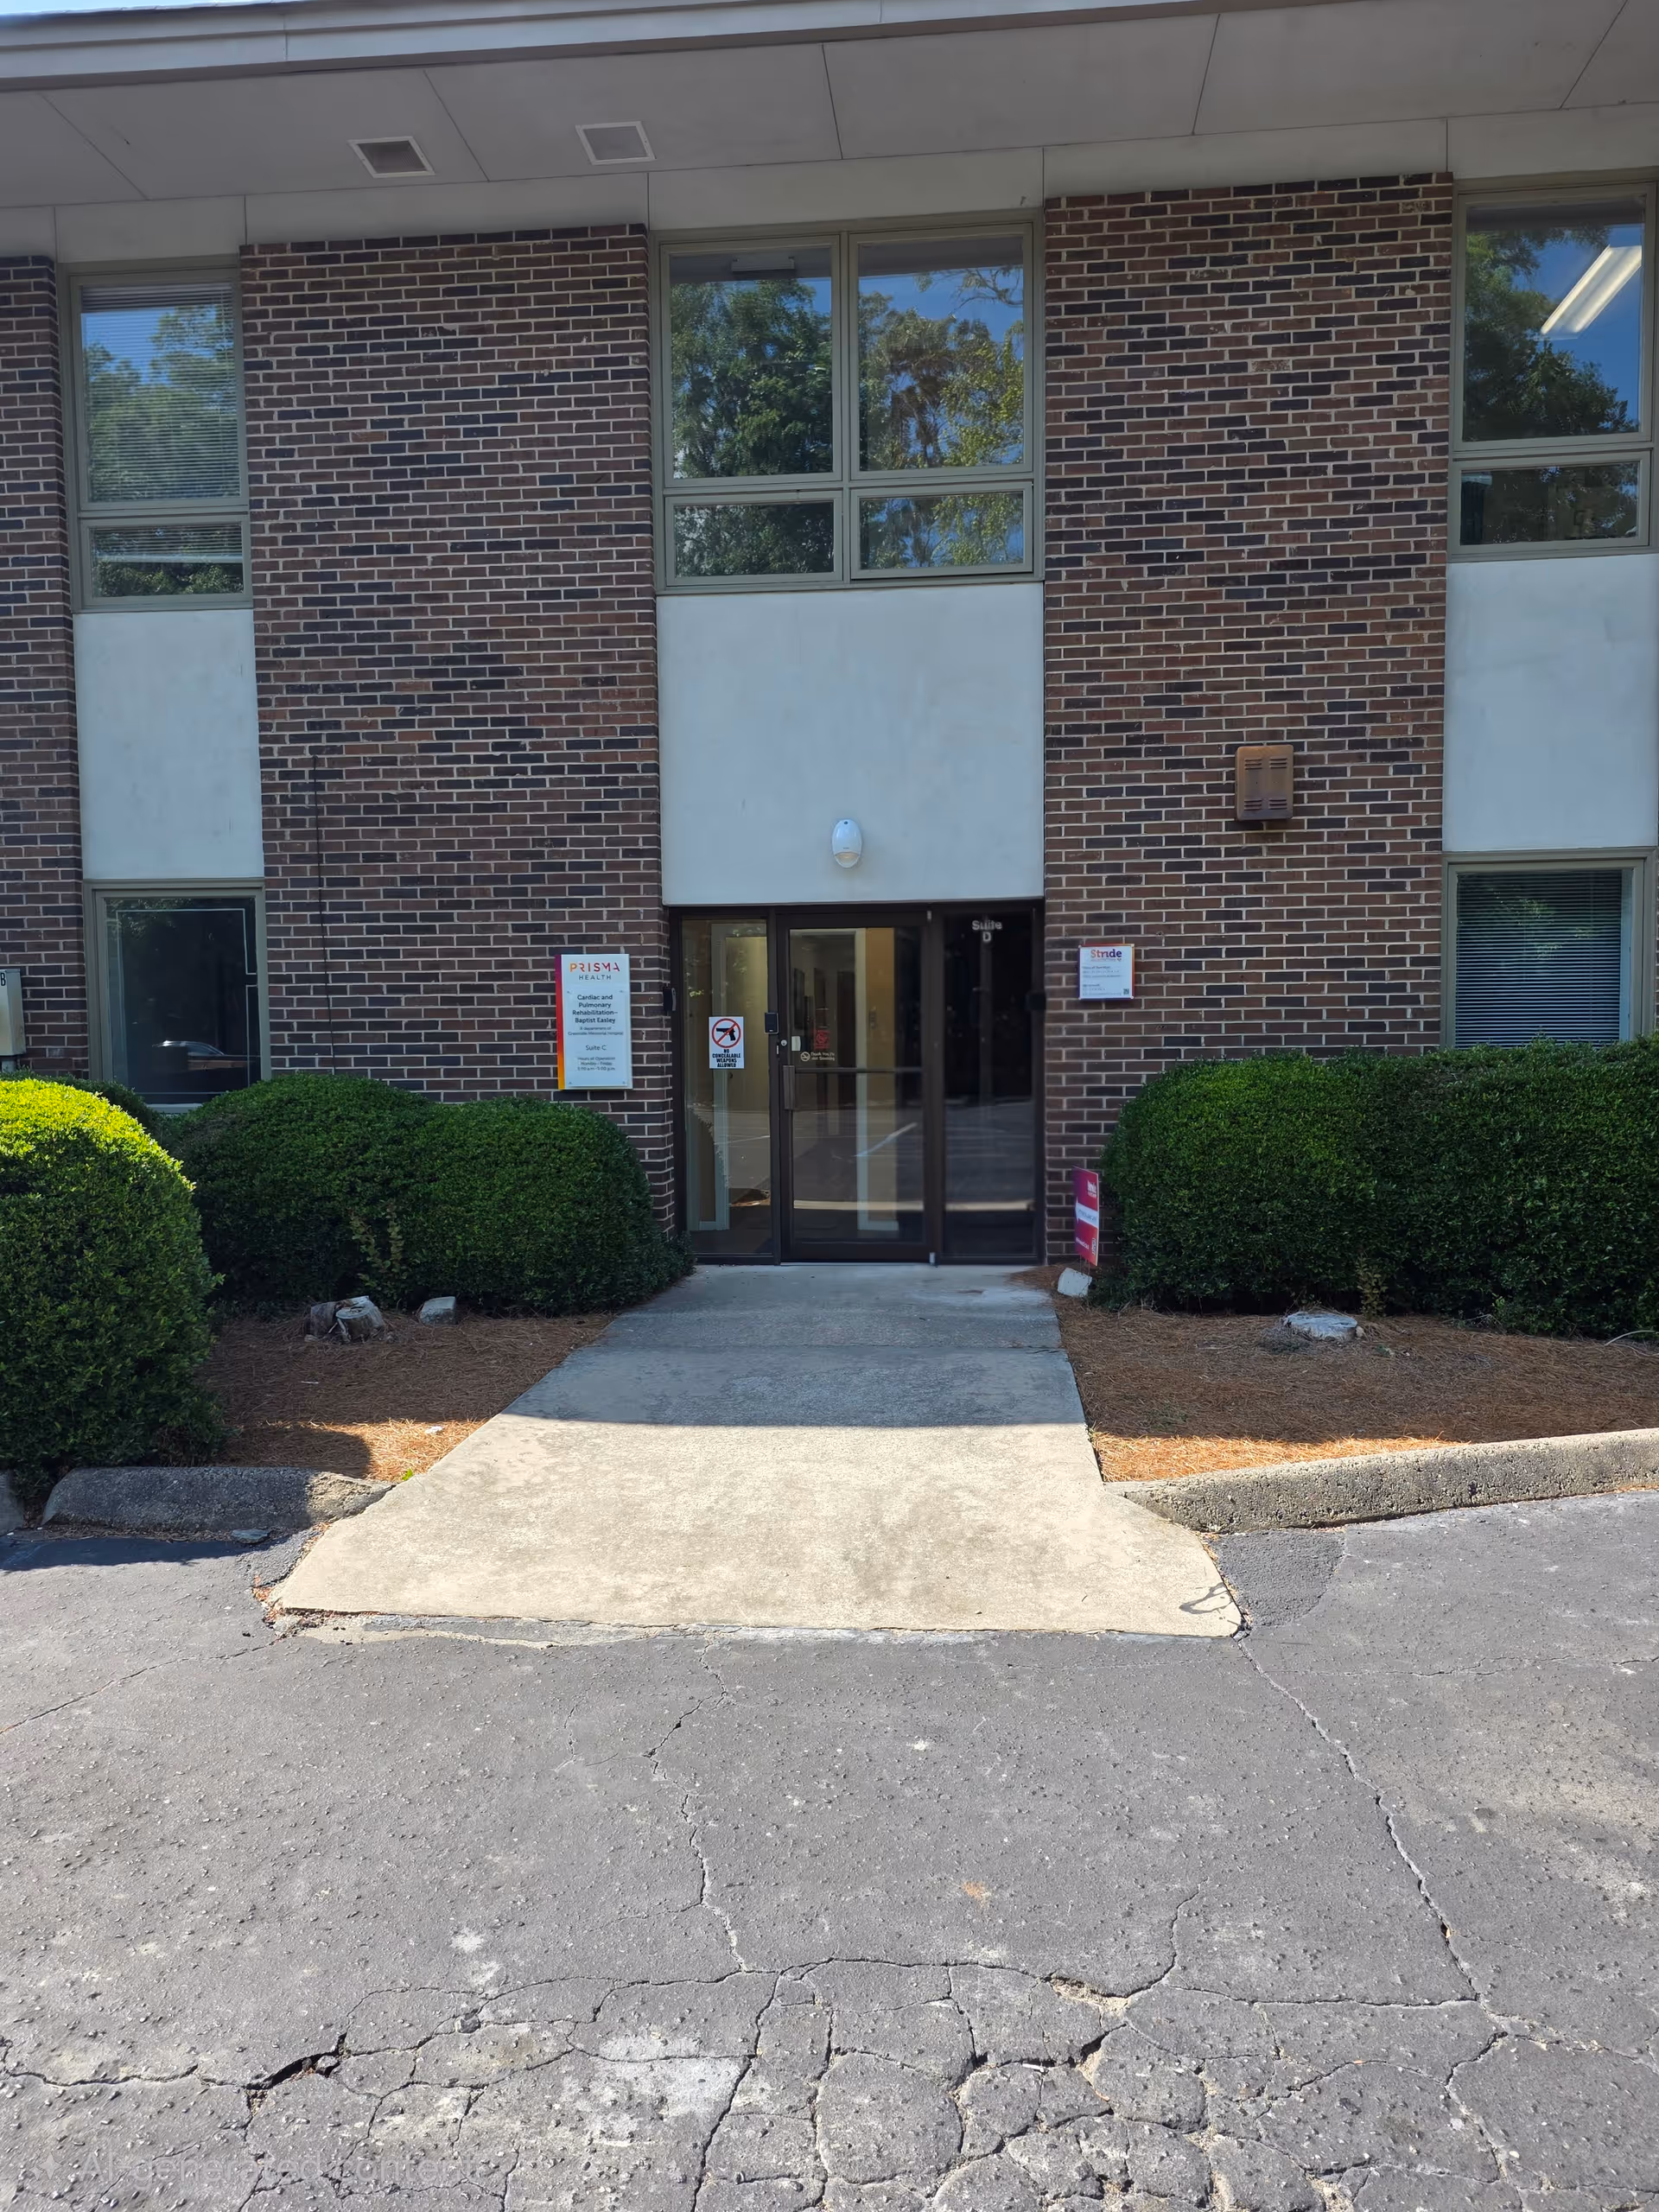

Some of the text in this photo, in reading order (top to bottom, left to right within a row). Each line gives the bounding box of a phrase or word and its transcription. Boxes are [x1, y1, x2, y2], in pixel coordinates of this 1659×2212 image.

[971, 919, 1003, 931] Suite
[982, 931, 992, 943] D
[1090, 949, 1122, 958] Stride
[569, 962, 620, 972] PRISMA
